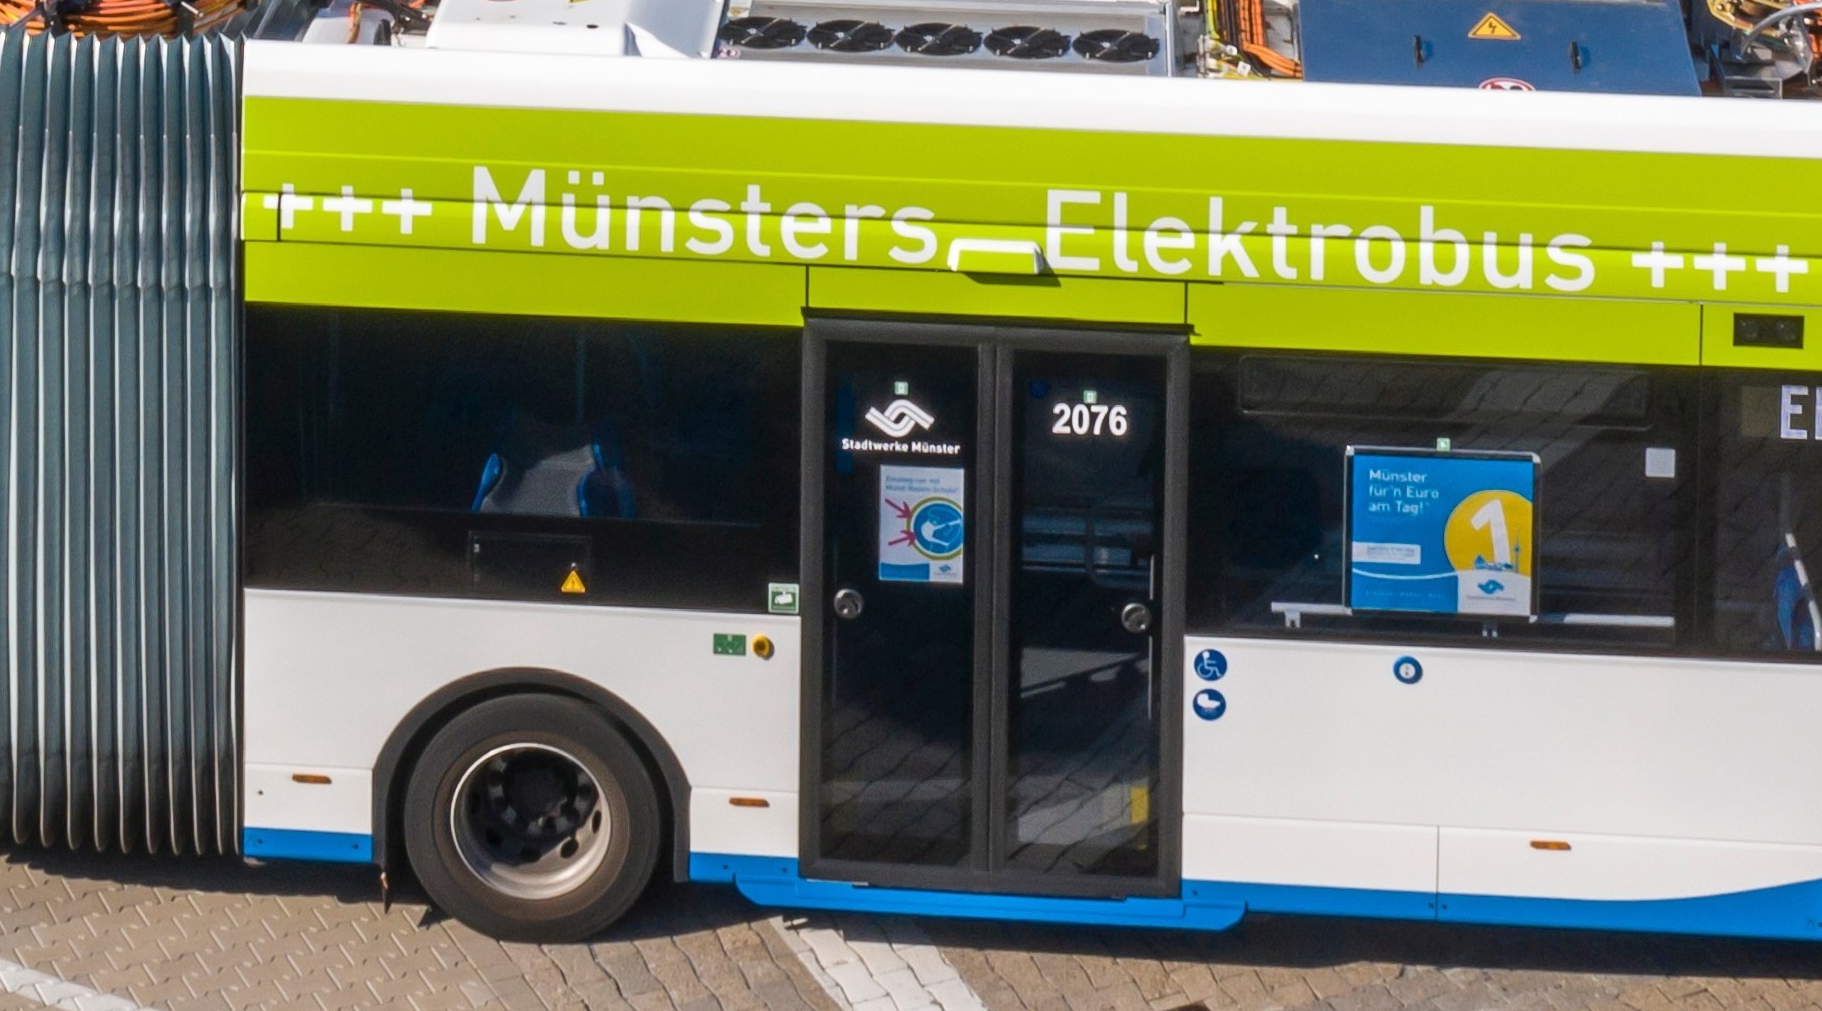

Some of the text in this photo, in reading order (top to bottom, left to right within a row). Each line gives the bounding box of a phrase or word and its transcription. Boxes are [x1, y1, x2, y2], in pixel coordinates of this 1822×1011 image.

[472, 165, 939, 264] Münsters
[1045, 189, 1595, 293] Elektrobus
[1052, 402, 1128, 436] 2076
[841, 437, 961, 455] Stadtwerke Münster
[1369, 468, 1429, 483] Münster
[1406, 485, 1440, 500] Euro
[1368, 503, 1391, 513] am
[1470, 498, 1512, 566] 1
